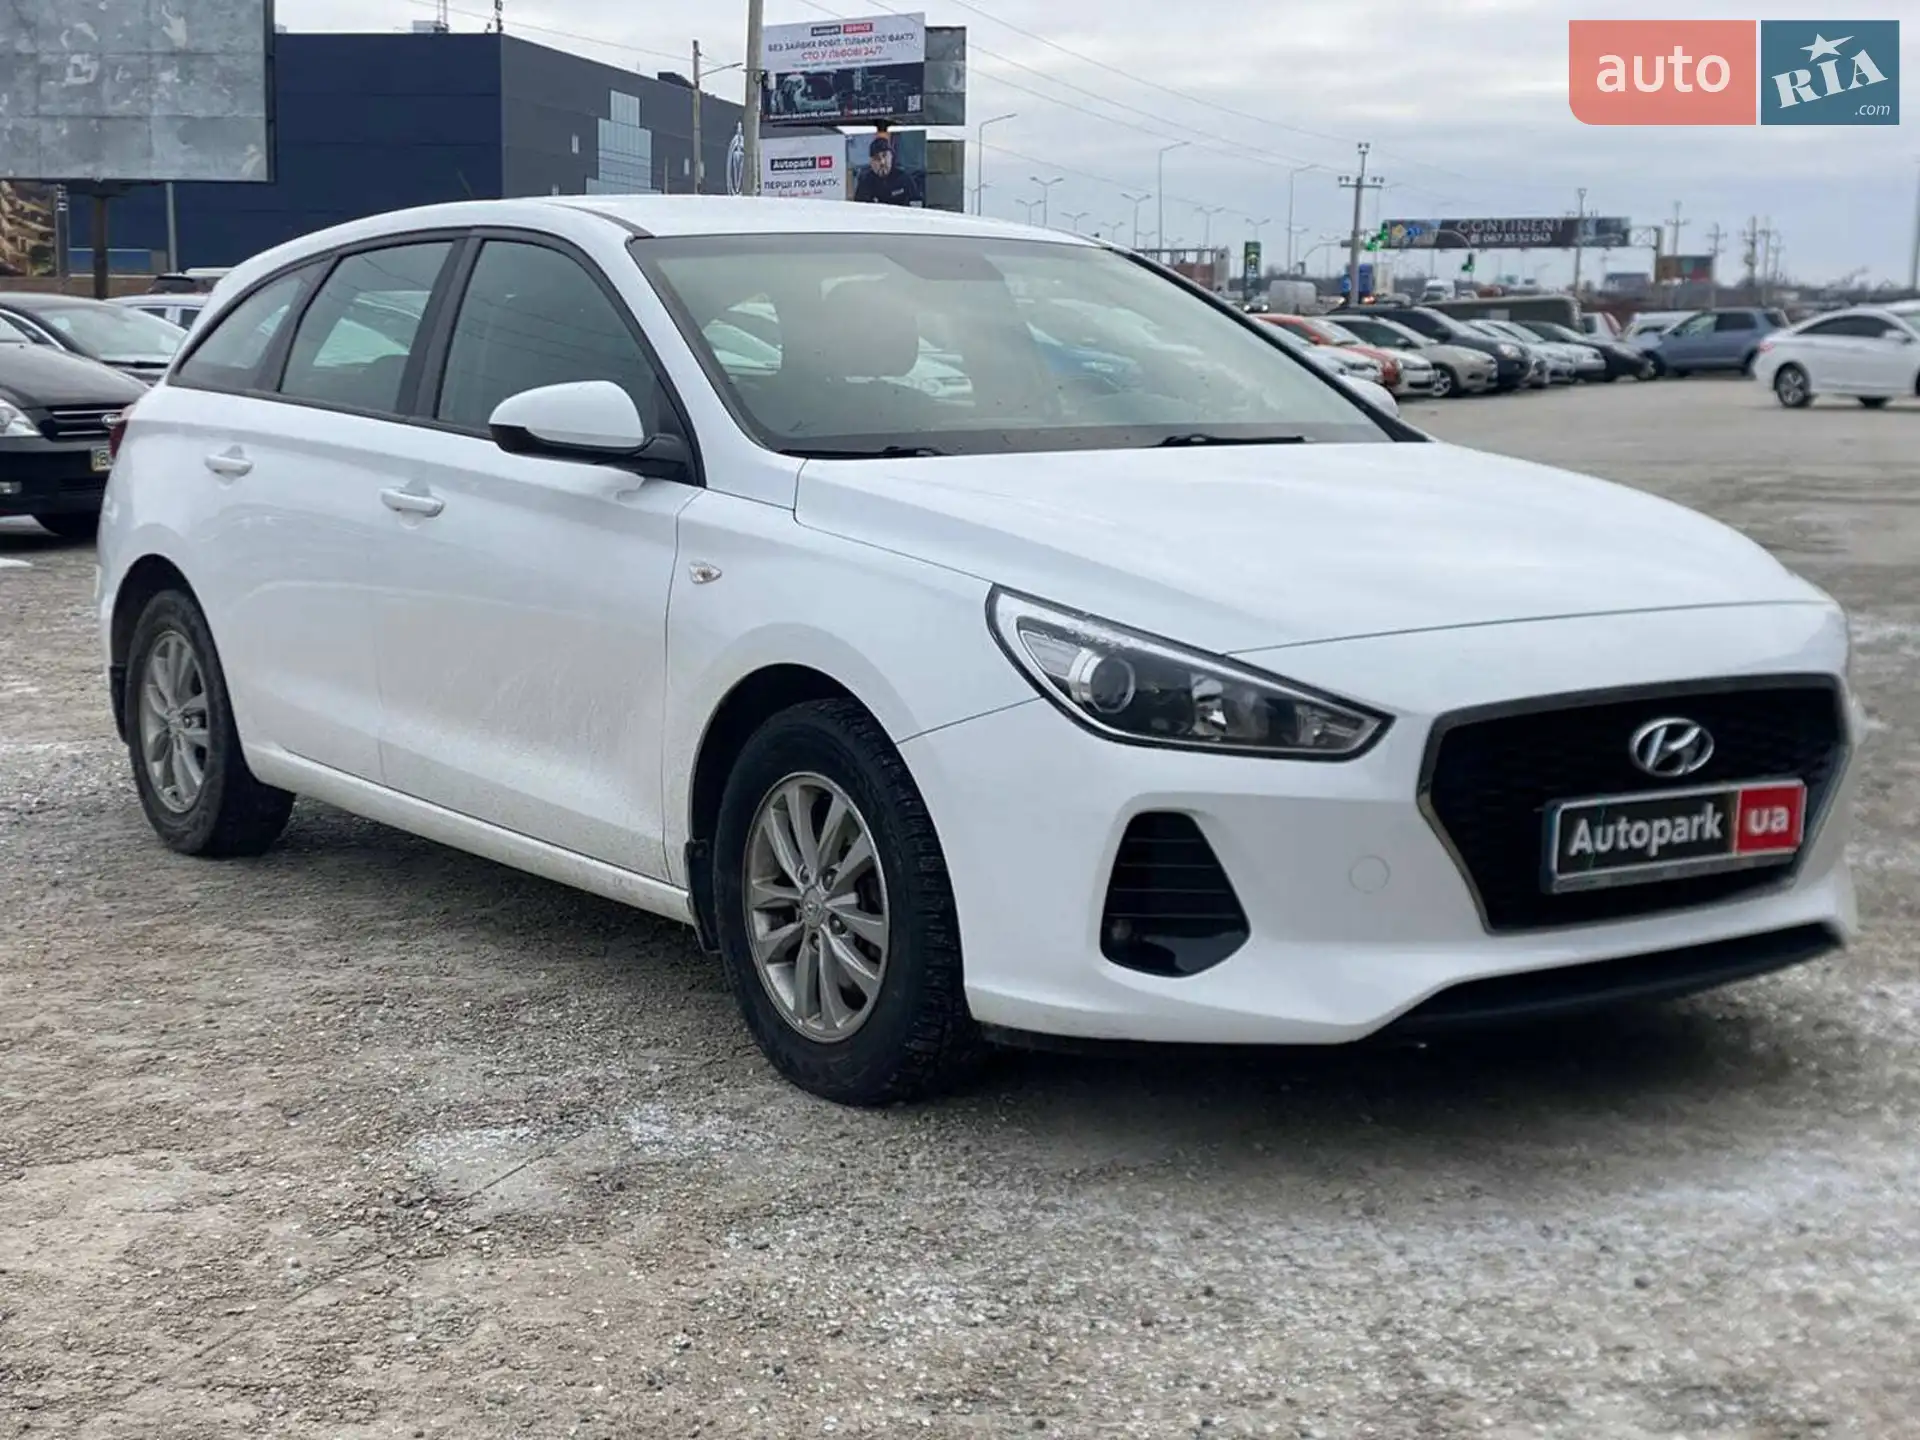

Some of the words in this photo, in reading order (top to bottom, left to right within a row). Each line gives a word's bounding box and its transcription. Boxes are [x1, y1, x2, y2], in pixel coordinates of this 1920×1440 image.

[768, 43, 783, 52] БЕЗ
[875, 34, 886, 43] ПО
[801, 51, 819, 60] СТО
[829, 46, 862, 58] ЛЬВОВІ
[864, 45, 883, 55] 24/7
[773, 158, 814, 170] Autopark
[764, 180, 792, 190] ПЕРШІ
[794, 179, 807, 188] ПО
[1456, 219, 1563, 233] CONTINENT
[1569, 802, 1724, 857] Autopark
[1748, 806, 1789, 836] ua
